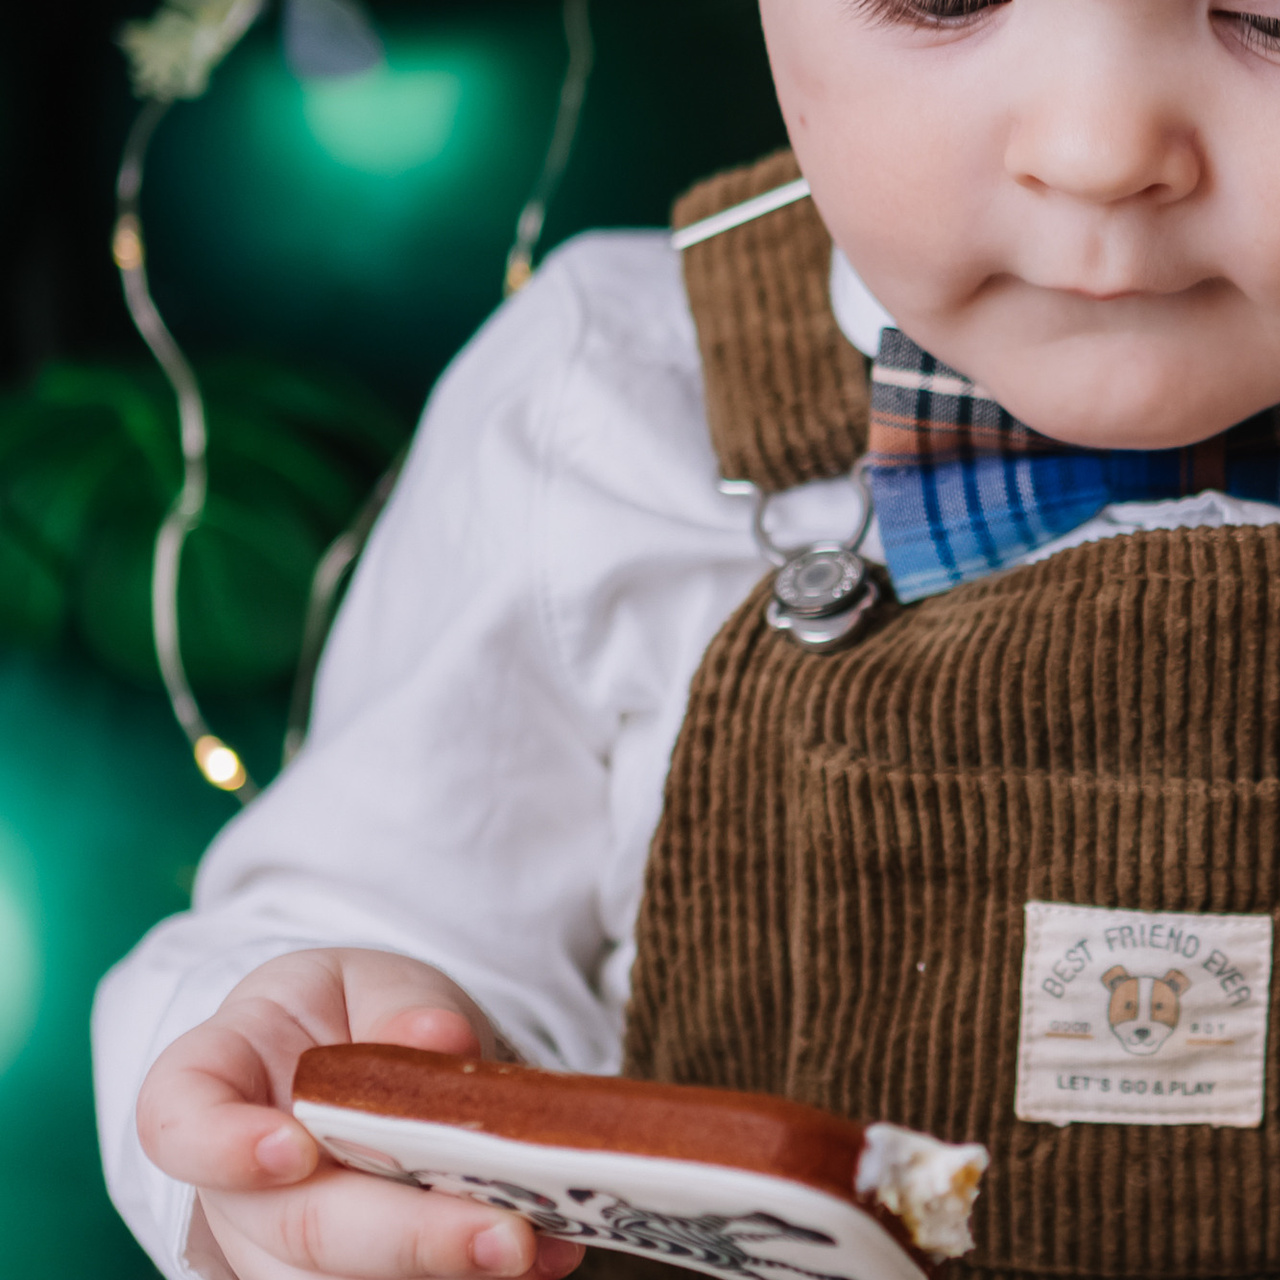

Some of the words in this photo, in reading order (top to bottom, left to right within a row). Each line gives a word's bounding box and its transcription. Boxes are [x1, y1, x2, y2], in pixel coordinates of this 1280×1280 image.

[1042, 937, 1093, 999] BEST
[1104, 924, 1200, 959] FRIEND
[1203, 949, 1251, 1007] EVER
[1057, 1075, 1111, 1092] LET'S
